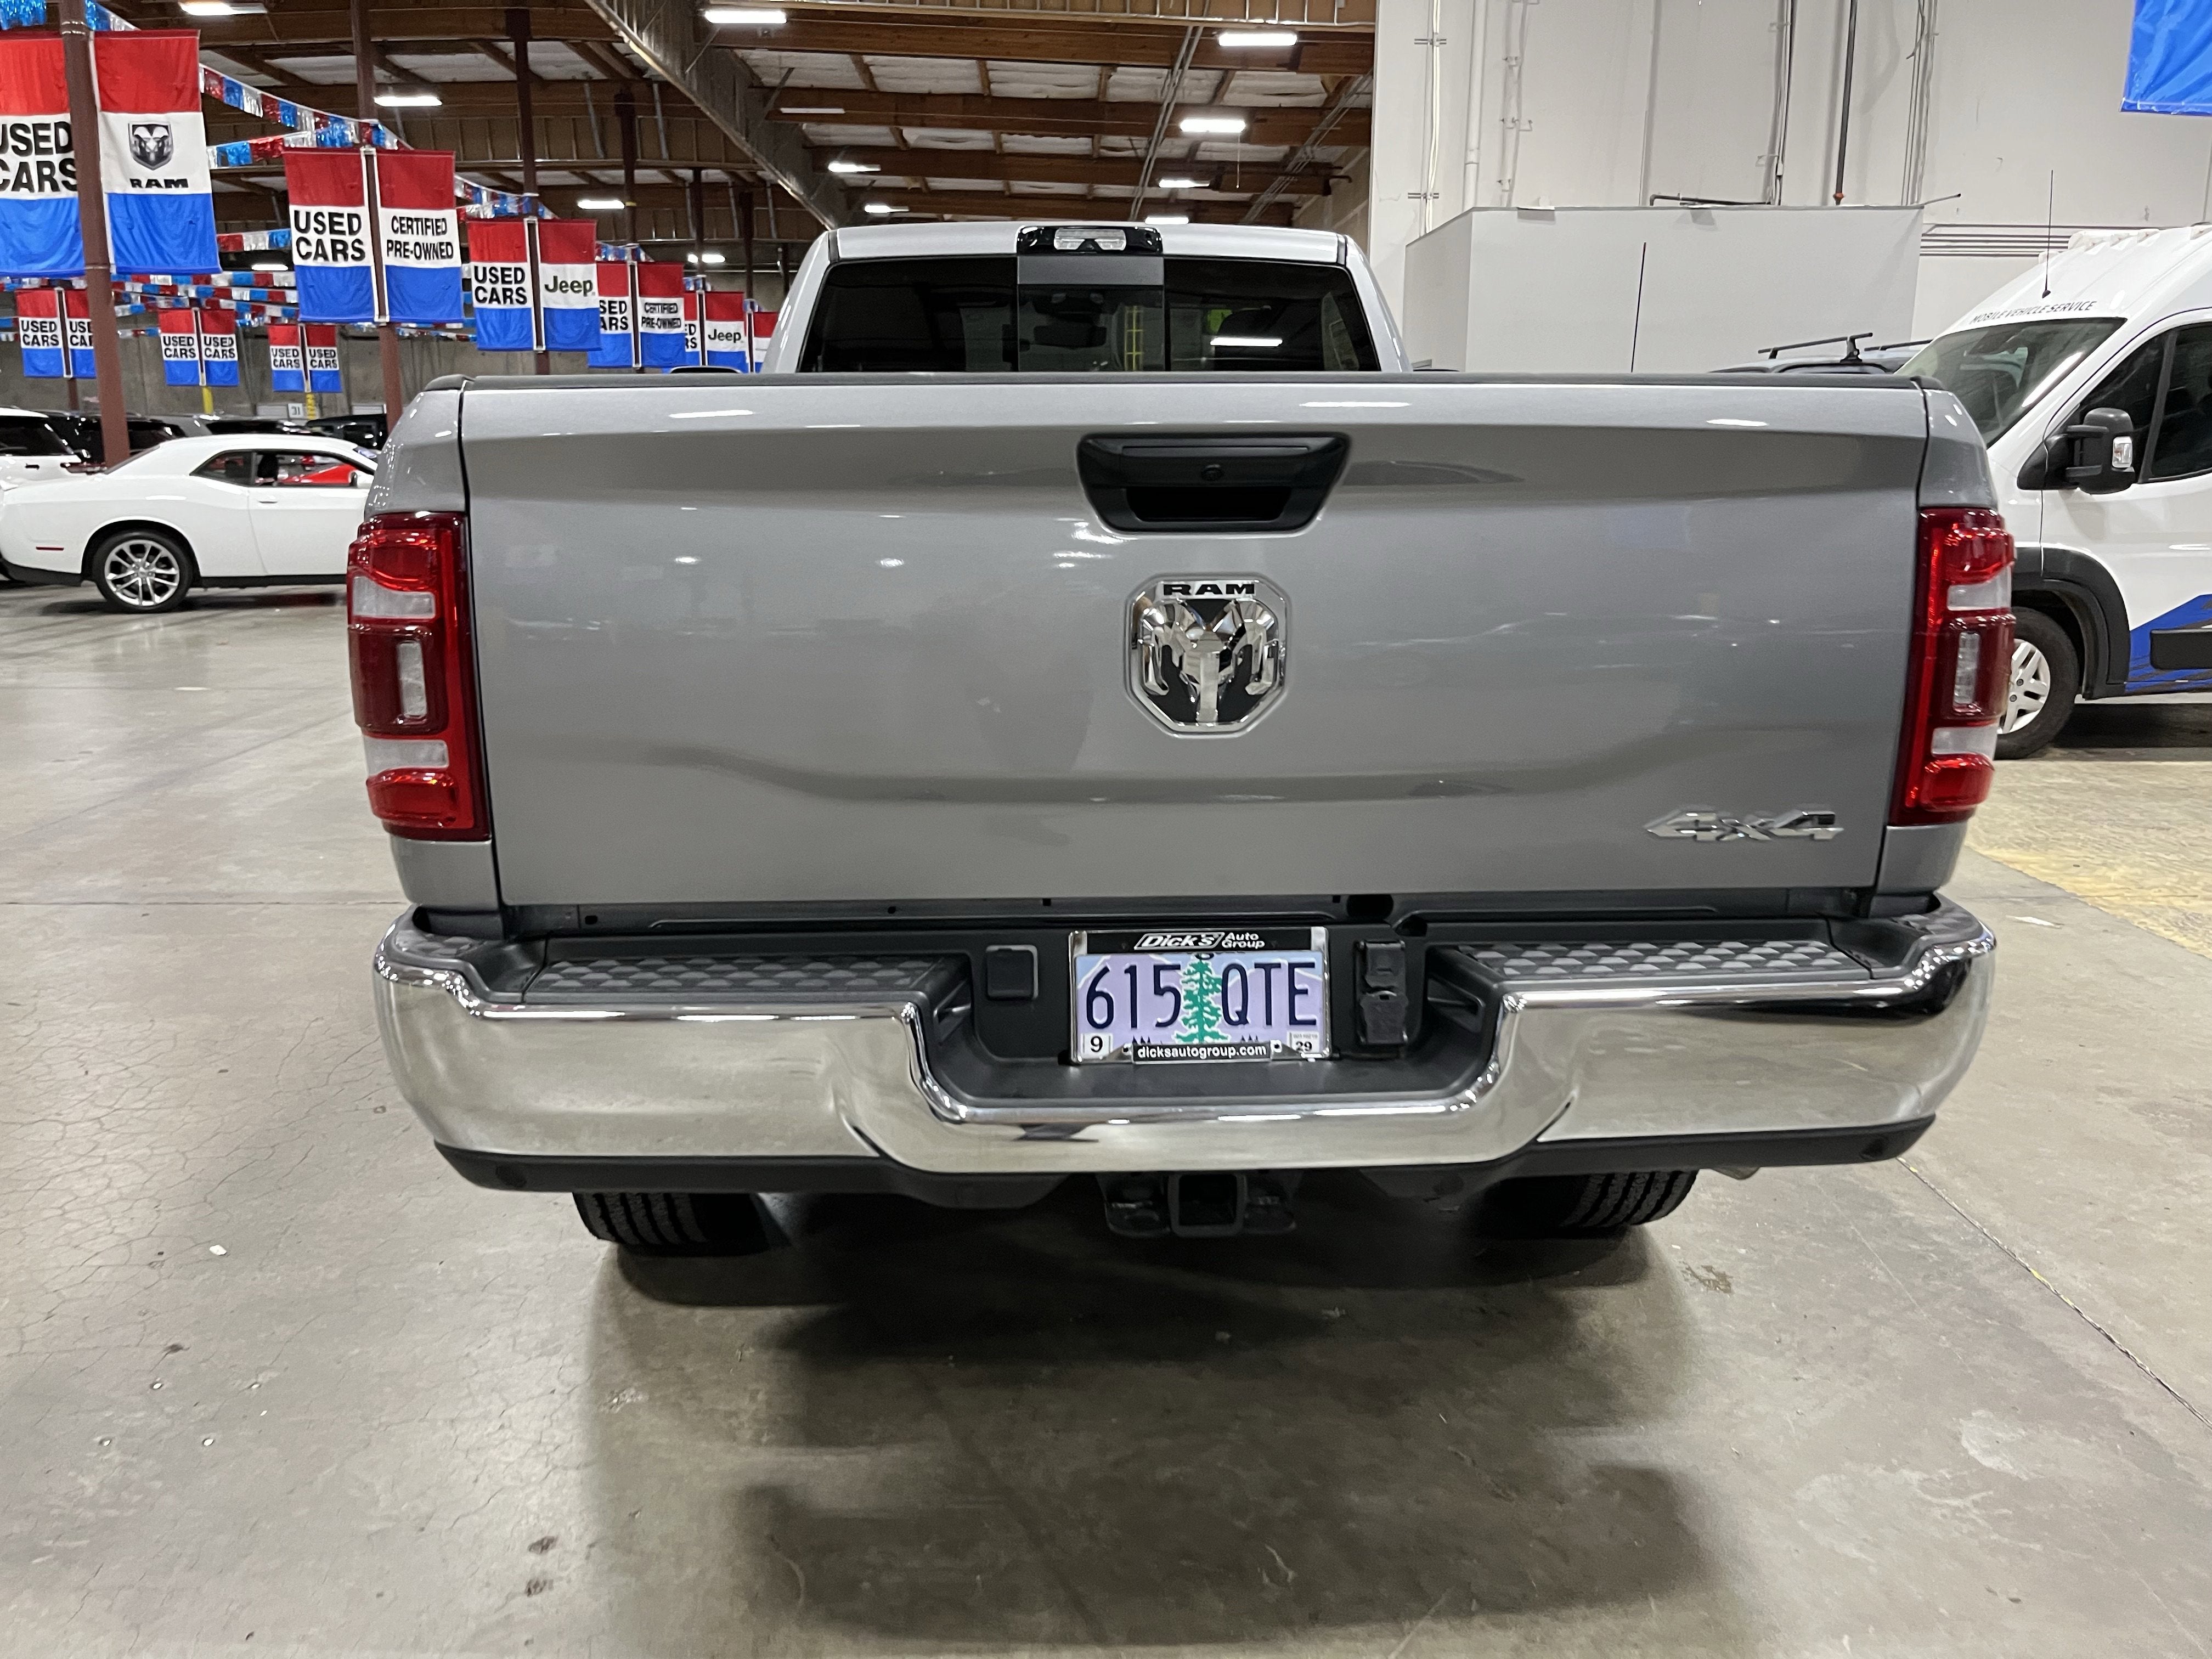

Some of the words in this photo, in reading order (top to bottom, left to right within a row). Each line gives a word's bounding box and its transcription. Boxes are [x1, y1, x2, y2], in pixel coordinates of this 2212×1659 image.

[129, 178, 189, 189] RAM
[294, 210, 362, 235] USED
[391, 216, 447, 236] CERTIFIED
[296, 236, 365, 262] CARS
[387, 239, 454, 260] PRE-OWNED
[474, 266, 525, 285] USED
[545, 275, 593, 297] Jeep
[475, 286, 528, 305] CARS
[600, 300, 627, 314] SED
[1970, 311, 2008, 325] MOBILE
[2005, 304, 2050, 318] VEHICLE
[2046, 301, 2097, 313] SERVICE
[21, 320, 57, 333] USED
[69, 320, 92, 334] US
[600, 316, 629, 331] ARS
[22, 334, 59, 347] CARS
[70, 334, 92, 347] CA
[163, 336, 194, 347] USED
[204, 336, 234, 347] USED
[708, 329, 742, 343] Jeep
[164, 347, 196, 358] CARS
[204, 347, 235, 359] CARS
[271, 348, 300, 358] USED
[309, 348, 336, 359] USED
[273, 359, 300, 369] CARS
[310, 359, 337, 369] CARS
[1163, 583, 1255, 596] RAM
[1226, 932, 1259, 941] Auto
[1221, 939, 1265, 949] Group
[1086, 964, 1182, 1029] 615
[1221, 962, 1317, 1027] QTE
[1090, 1036, 1103, 1052] 9
[1296, 1041, 1312, 1052] 29
[1137, 1046, 1267, 1059] dicksautogroup.com
